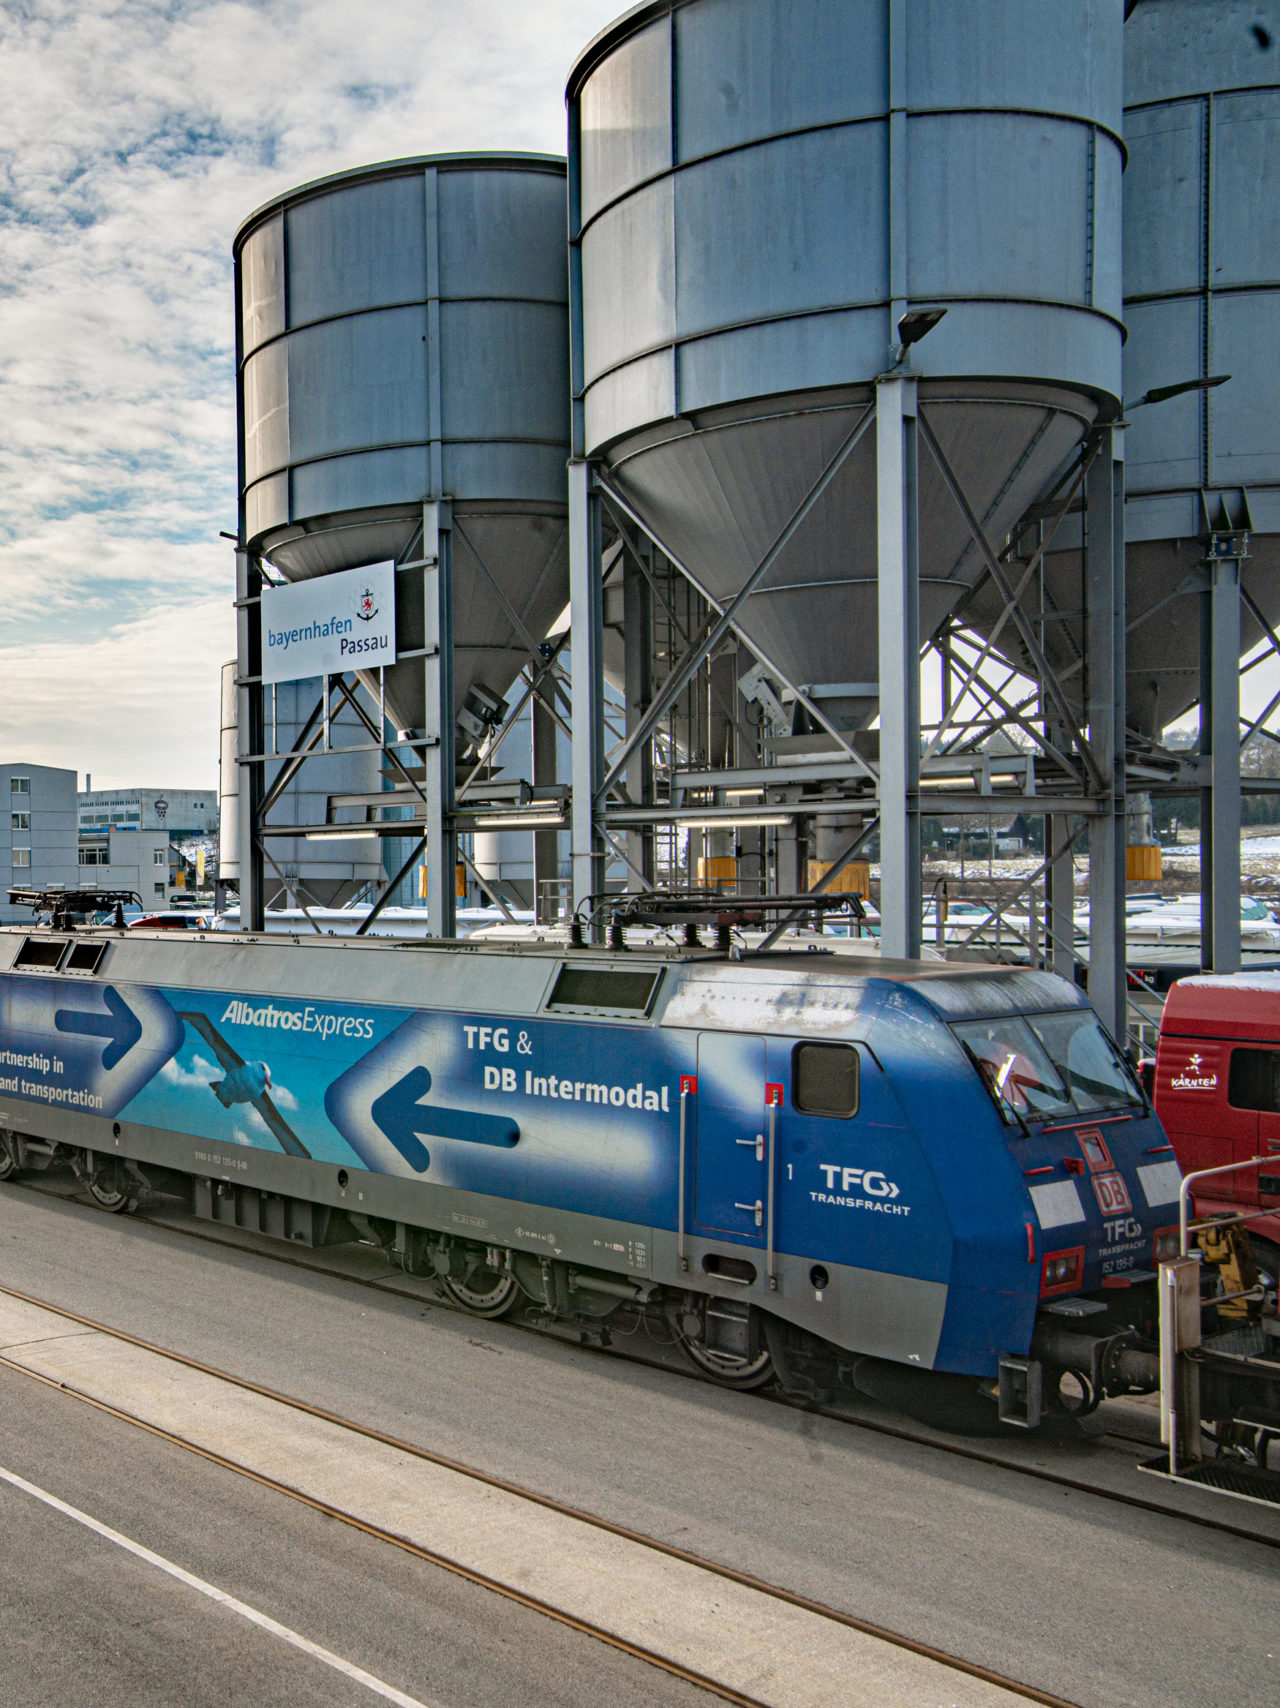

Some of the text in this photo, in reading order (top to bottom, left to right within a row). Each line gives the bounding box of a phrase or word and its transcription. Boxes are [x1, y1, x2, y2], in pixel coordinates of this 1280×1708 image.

[268, 616, 353, 650] bayernhafen
[340, 634, 388, 655] Passau
[221, 1000, 375, 1040] AlbatrosExpress
[463, 1025, 533, 1055] TFG &
[52, 1055, 64, 1073] in
[20, 1078, 103, 1110] transportation
[484, 1065, 670, 1113] DB Intermodal
[786, 1163, 793, 1180] 1
[820, 1164, 888, 1195] TFG
[809, 1191, 912, 1217] TRANSFRACHT
[1097, 1179, 1126, 1209] DB
[1103, 1217, 1137, 1242] TFG
[1098, 1239, 1147, 1257] TRANSFRACHT
[1102, 1260, 1114, 1273] 152
